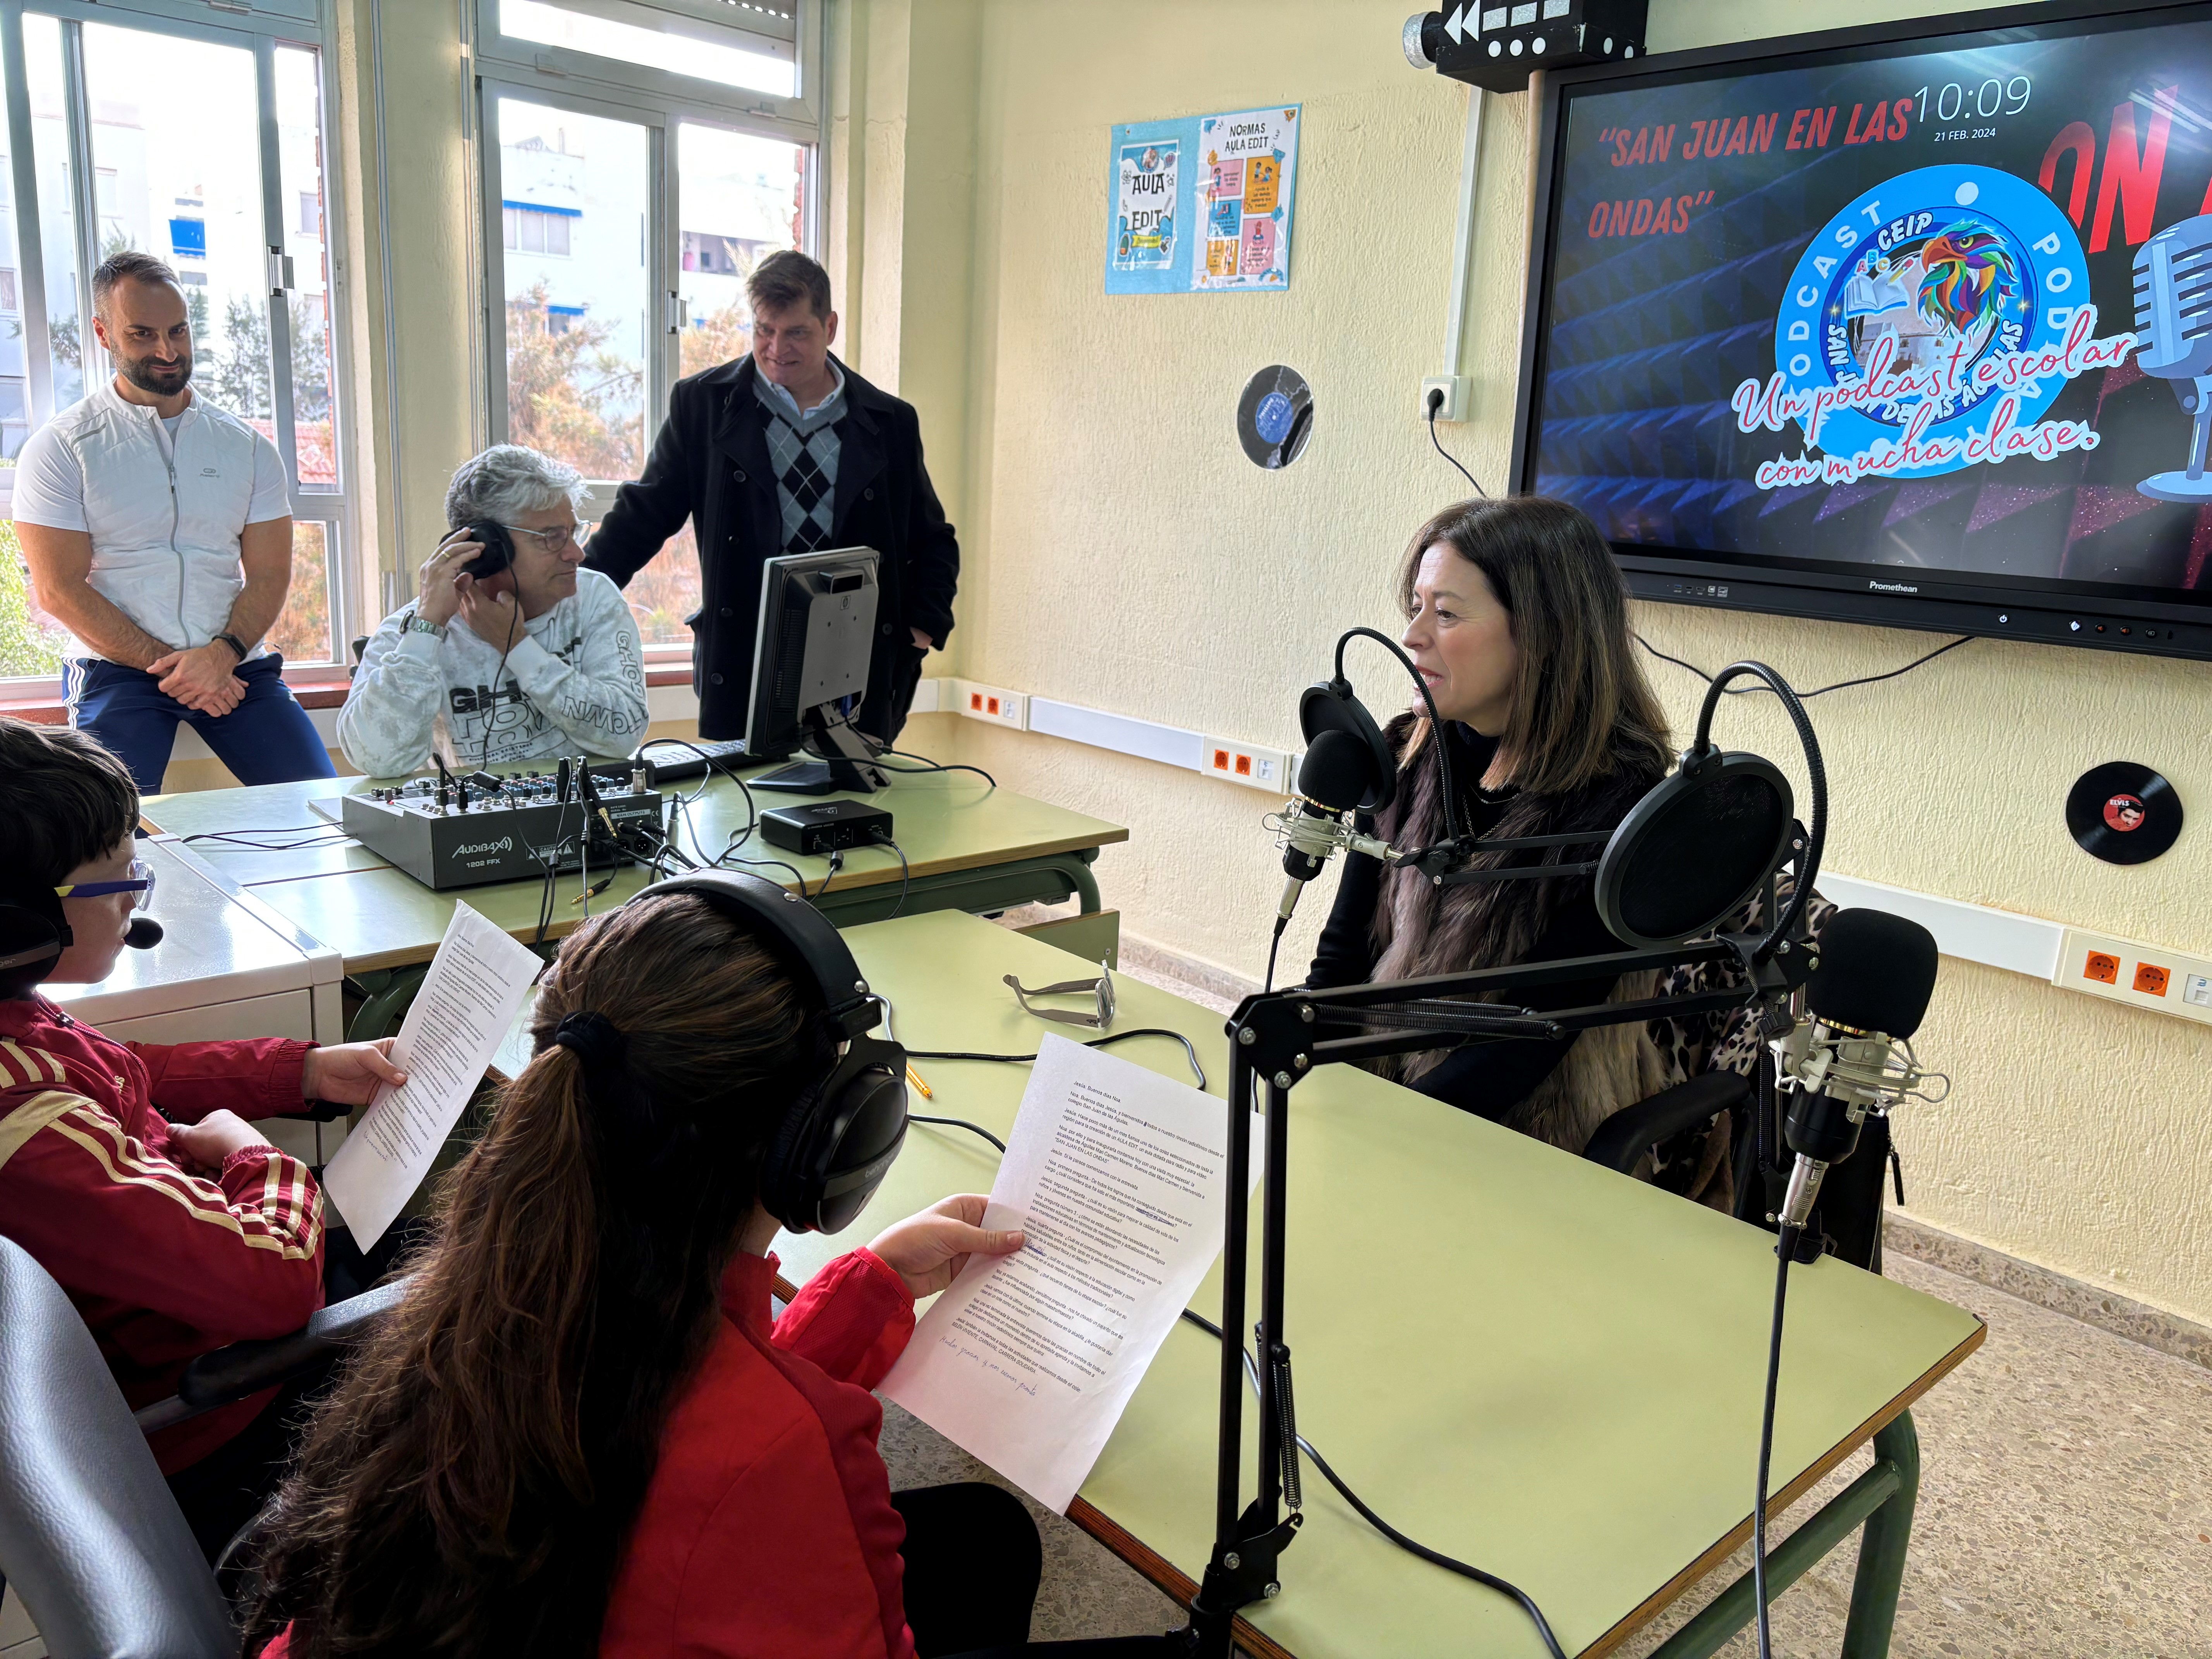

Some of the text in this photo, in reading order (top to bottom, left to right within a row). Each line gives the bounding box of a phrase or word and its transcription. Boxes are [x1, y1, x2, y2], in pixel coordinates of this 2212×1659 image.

[1914, 76, 2032, 123] 10:09
[1229, 122, 1266, 137] NORMAS
[1683, 113, 1779, 160] JUAN
[1785, 106, 1837, 150] EN
[1843, 98, 1913, 145] LAS
[1934, 127, 1996, 142] 21 FEB. 2024
[1224, 136, 1269, 152] AULA EDIT
[1132, 173, 1164, 195] AULA
[1132, 209, 1162, 230] EDIT
[1877, 212, 1933, 251] CEIP
[1788, 200, 1881, 377] ODCAST
[1827, 324, 1850, 366] SAN
[1736, 310, 2131, 441] Un podcast escolar
[1760, 397, 2095, 484] con mucha clase.
[1869, 580, 1918, 593] Promethean
[2109, 799, 2130, 807] ELVIS
[452, 836, 508, 859] AUDIBAX
[466, 860, 485, 868] 1202
[1015, 1382, 1037, 1396] pronto
